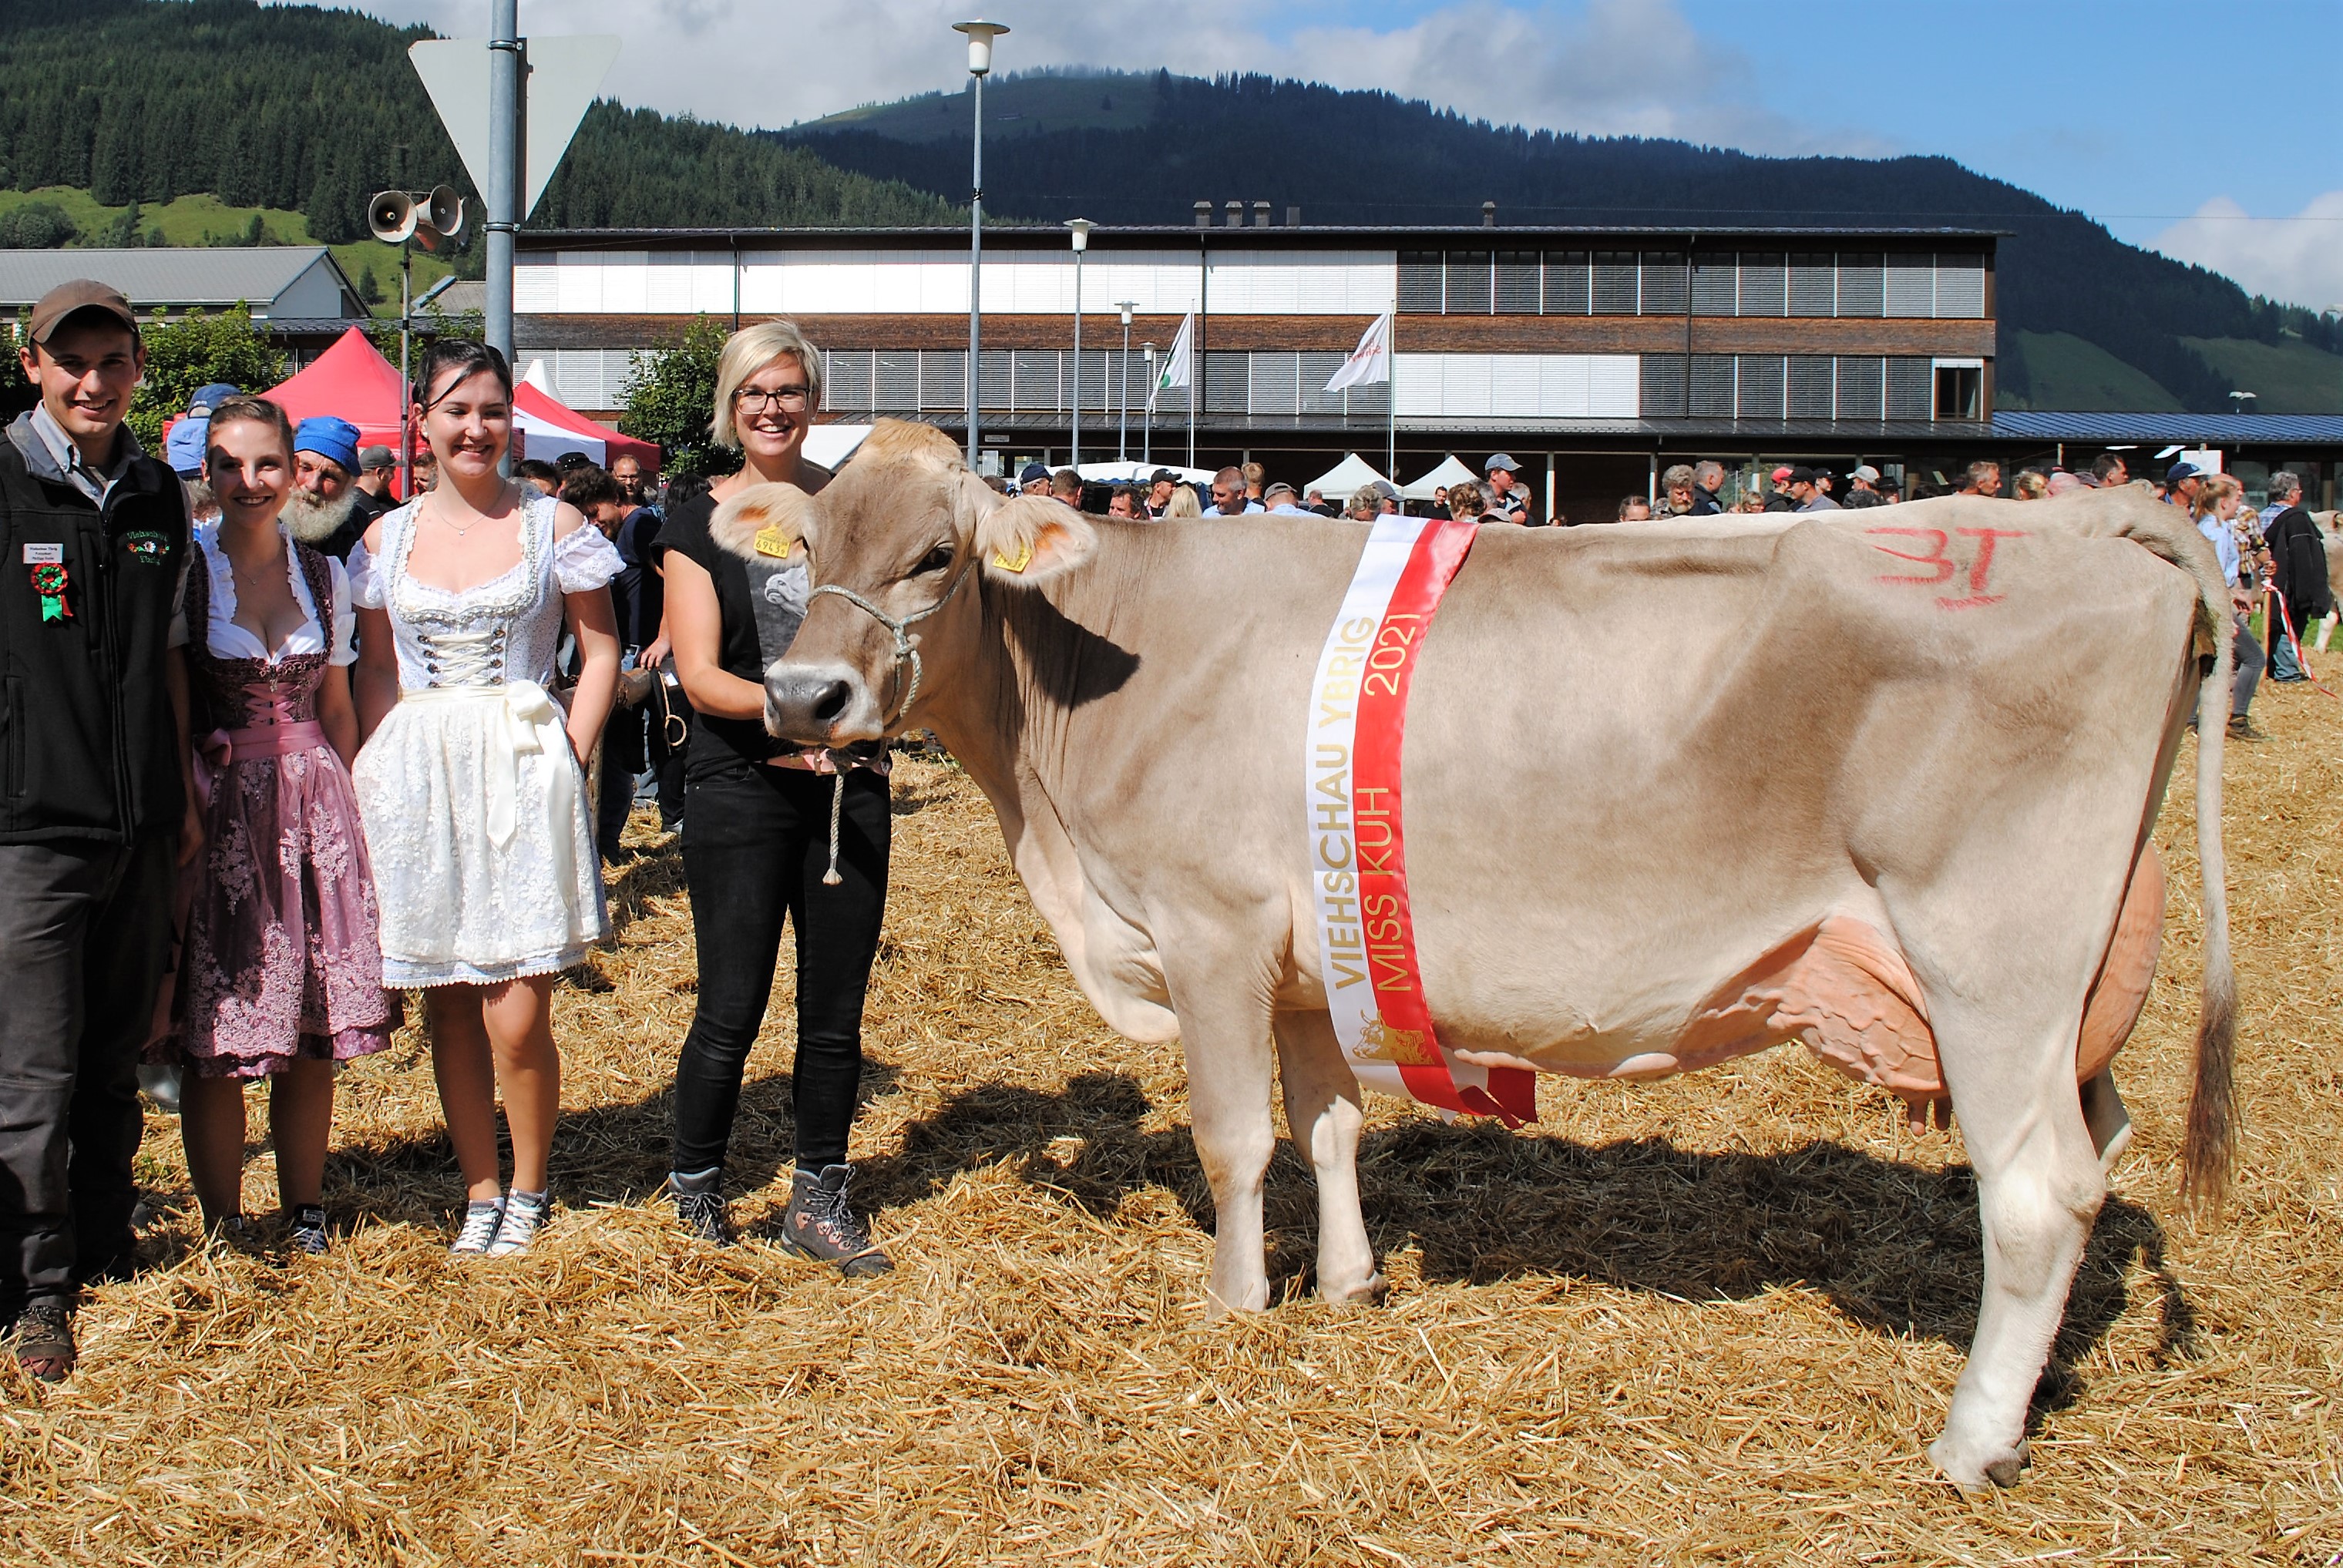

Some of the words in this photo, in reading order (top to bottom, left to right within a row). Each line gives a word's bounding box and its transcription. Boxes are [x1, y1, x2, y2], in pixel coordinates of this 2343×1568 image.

[1319, 617, 1376, 728] YBRIG
[1363, 613, 1421, 696] 2021
[1315, 744, 1366, 990] VIEHSCHAU
[1356, 787, 1394, 876] KUH
[1363, 894, 1412, 992] MISS
